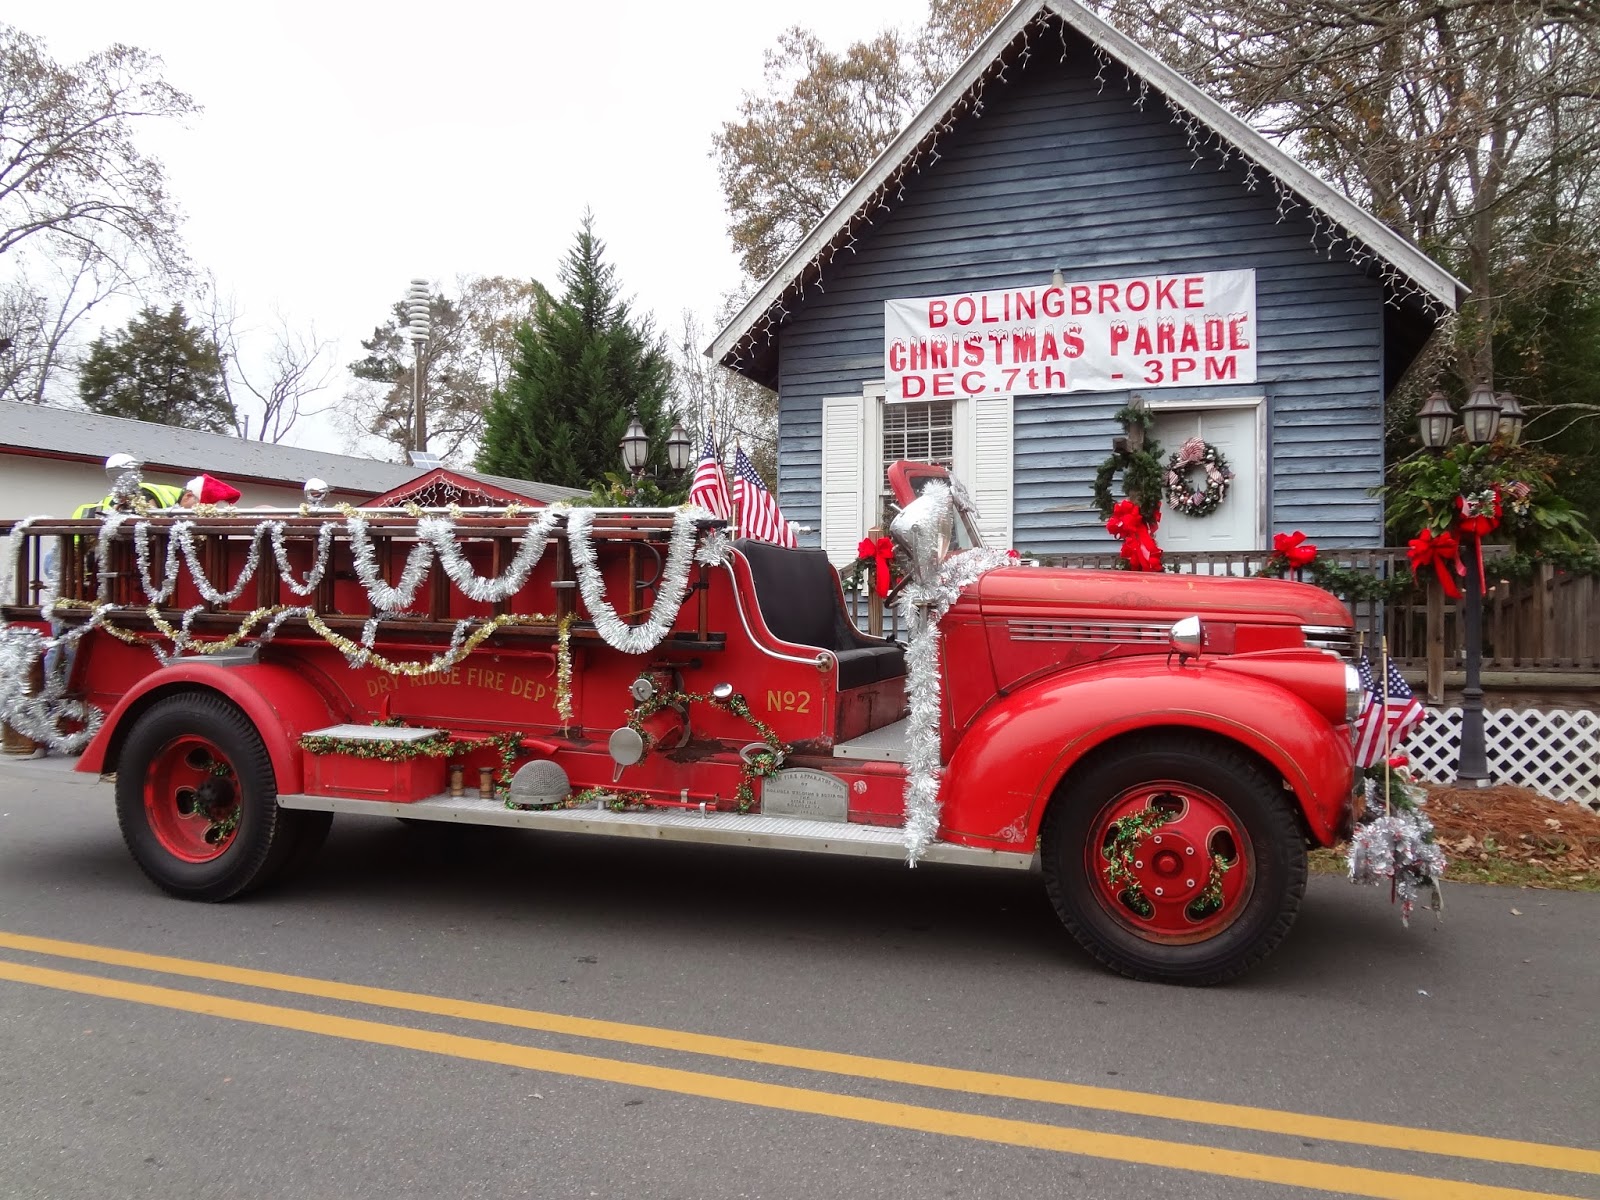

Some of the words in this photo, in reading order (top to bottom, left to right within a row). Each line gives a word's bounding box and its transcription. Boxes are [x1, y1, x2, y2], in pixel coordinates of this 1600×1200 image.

[928, 277, 1205, 329] BOLINGBROKE
[889, 321, 1085, 373] CHRISTMAS
[1109, 311, 1250, 357] PARADE
[1143, 355, 1237, 384] 3PM
[366, 674, 400, 698] DRY
[409, 667, 462, 688] RIDGE
[467, 667, 506, 692] FIRE
